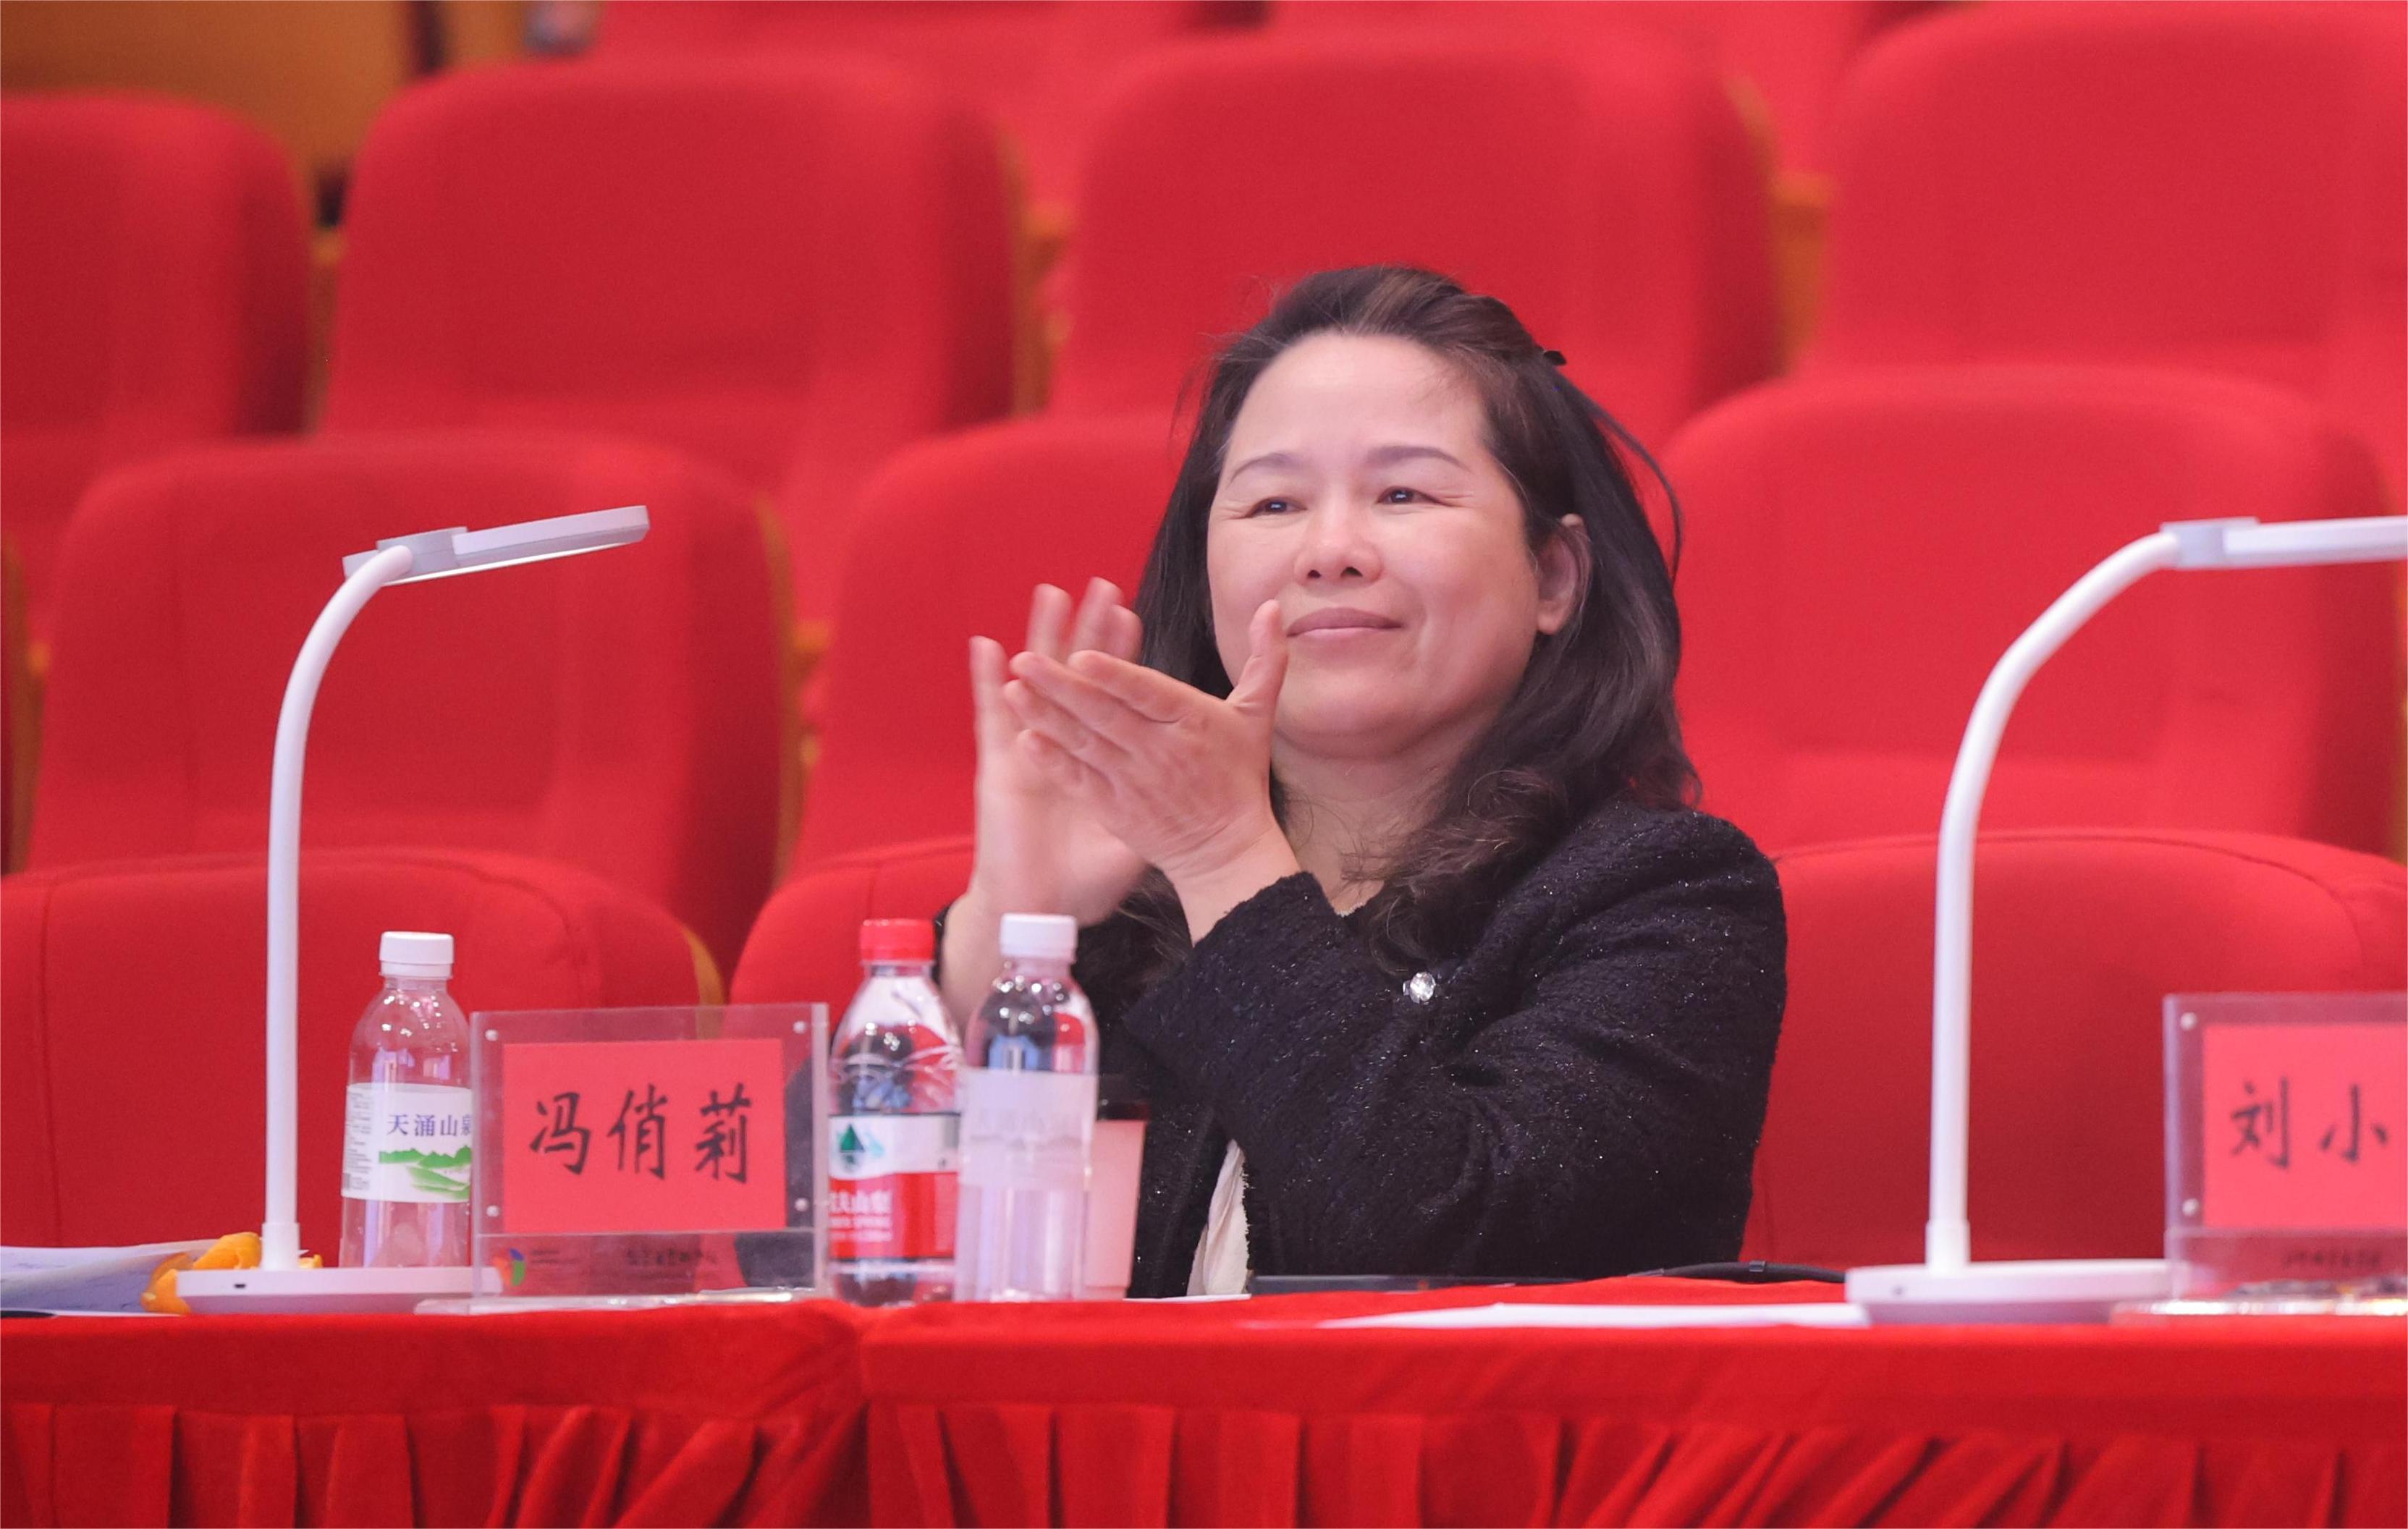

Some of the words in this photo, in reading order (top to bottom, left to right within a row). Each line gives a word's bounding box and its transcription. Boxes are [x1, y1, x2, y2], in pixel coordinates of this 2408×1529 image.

[529, 1083, 753, 1184] 冯俏莉
[2230, 1075, 2388, 1169] 刘小
